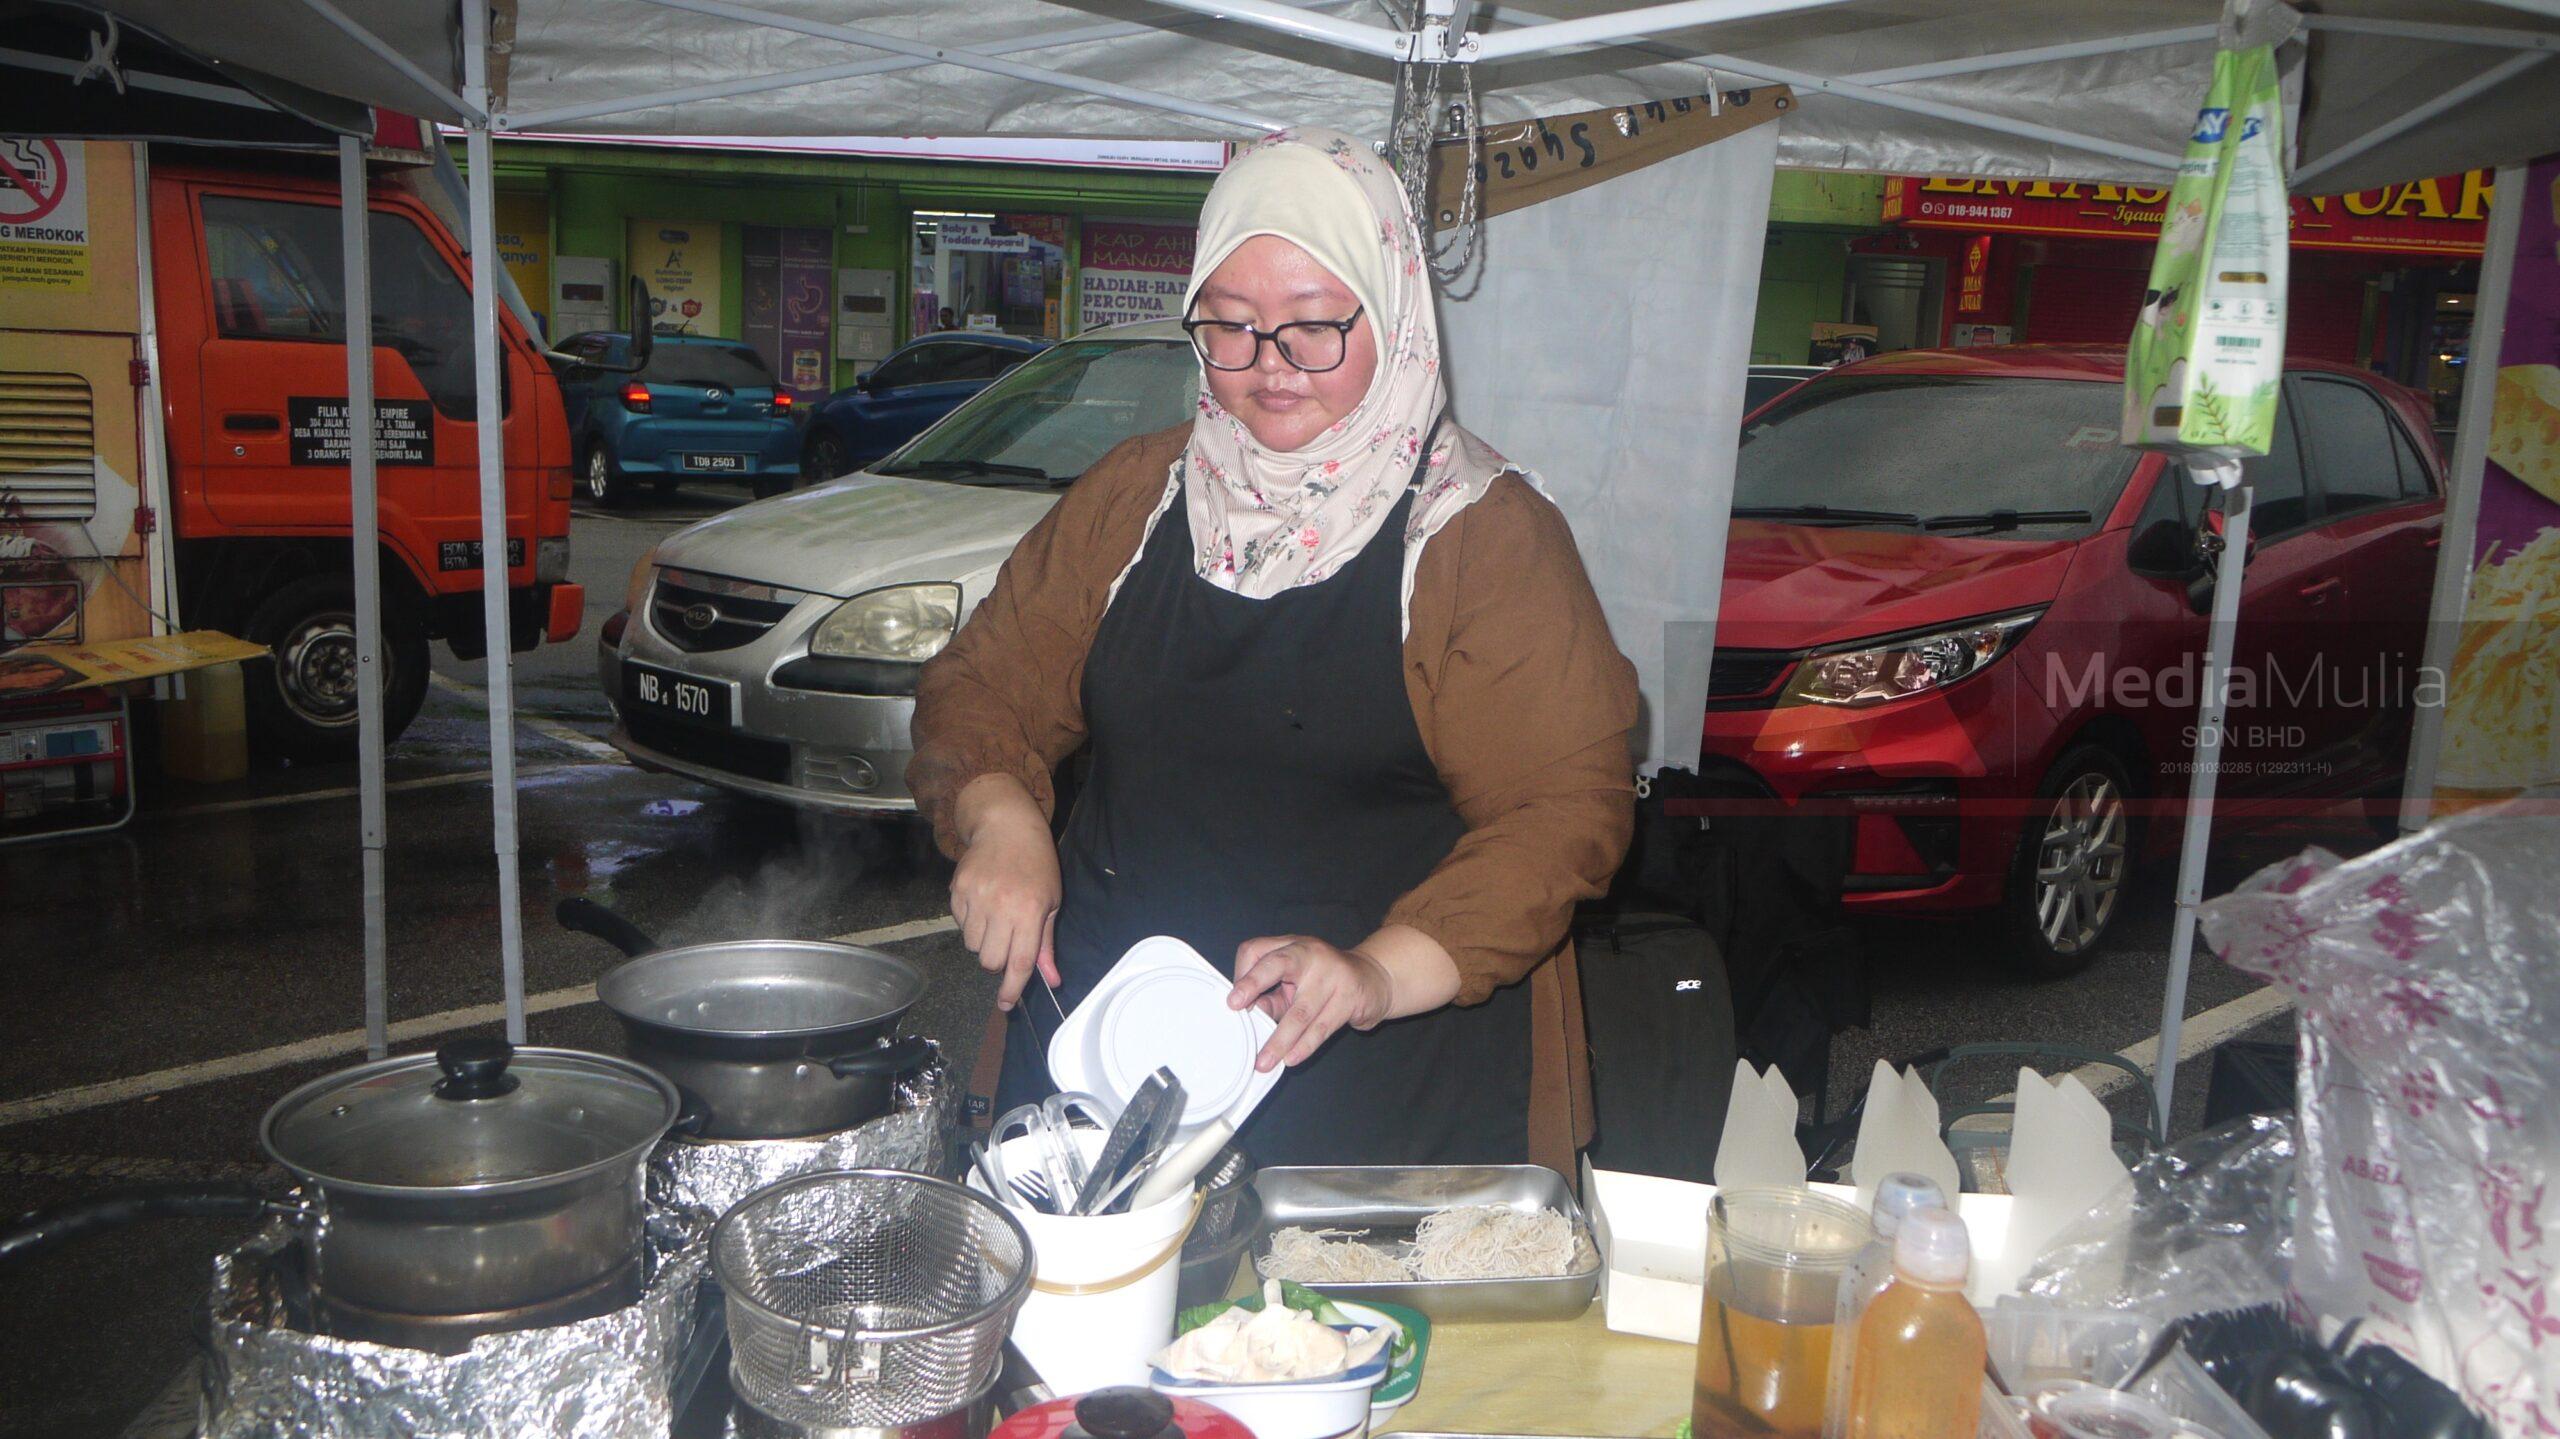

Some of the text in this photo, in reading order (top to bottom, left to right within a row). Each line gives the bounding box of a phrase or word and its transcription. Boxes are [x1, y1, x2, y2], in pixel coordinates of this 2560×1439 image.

[1990, 205, 2013, 219] 1367
[0, 225, 85, 242] G MEROKOK
[941, 224, 978, 235] Baby &
[941, 235, 1024, 248] Toddler Apparel
[499, 250, 538, 266] anya
[1093, 251, 1192, 269] MANJAK
[1083, 276, 1189, 296] HADIAH-HAD
[1083, 294, 1164, 311] PERCUMA
[1083, 311, 1140, 325] UNTUK
[317, 406, 338, 418] FILIA
[380, 407, 409, 419] EMPIRE
[324, 418, 344, 428] JALAN
[394, 419, 416, 429] TAMAN
[294, 427, 351, 438] DESA KIARA SIKA
[383, 429, 415, 440] SEREMBAN
[323, 438, 351, 449] BARAN
[389, 440, 407, 450] SAJA
[307, 449, 313, 459] 3
[314, 449, 340, 459] ORANG
[405, 450, 423, 460] SAJA
[712, 457, 735, 468] 2503
[640, 672, 709, 716] NB 1570
